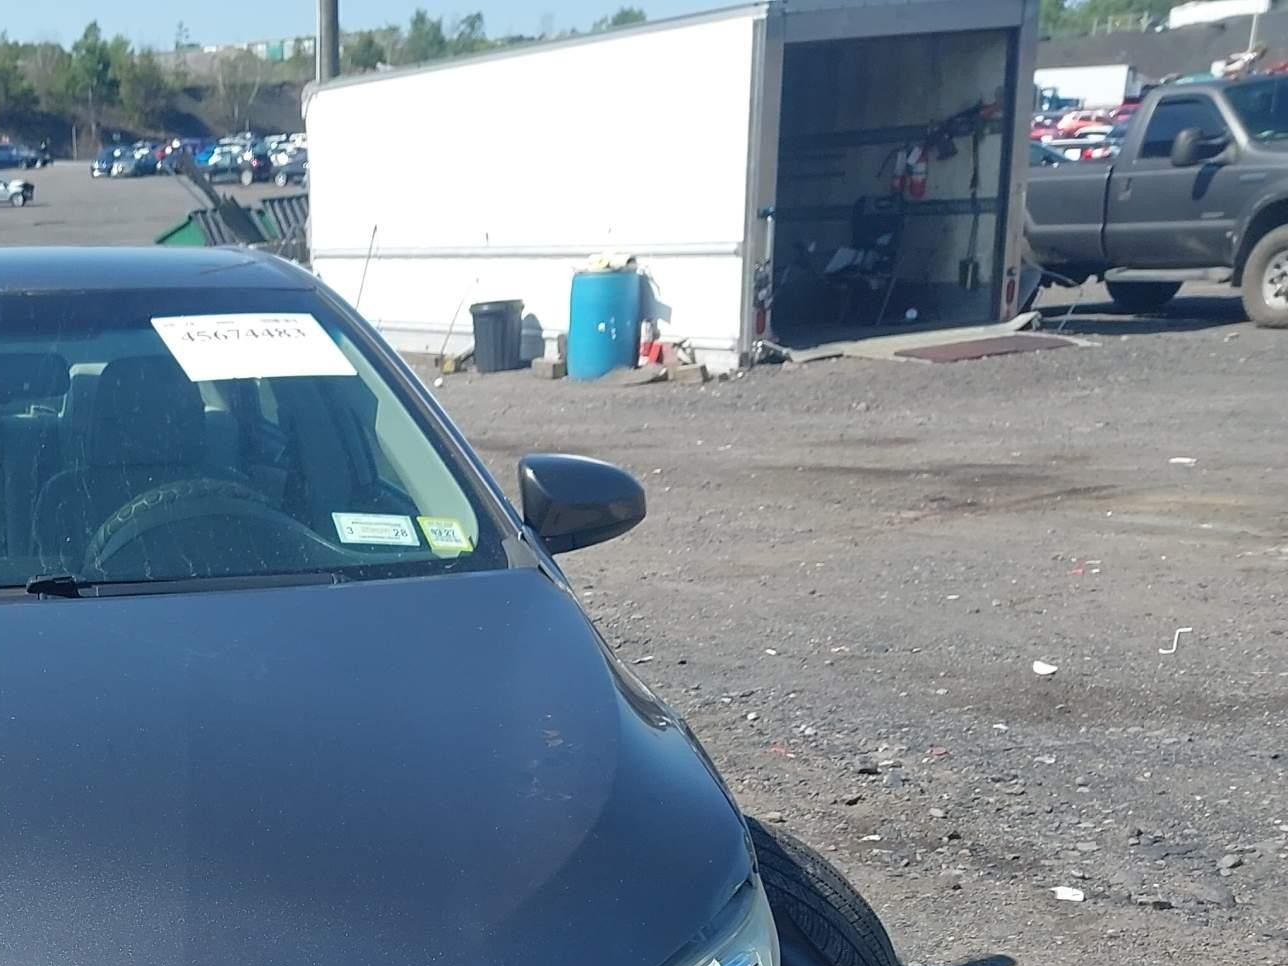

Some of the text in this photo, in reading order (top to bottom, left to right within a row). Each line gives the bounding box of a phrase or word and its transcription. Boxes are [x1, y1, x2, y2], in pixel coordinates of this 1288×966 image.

[182, 327, 306, 343] 45674483
[346, 526, 354, 535] 3
[392, 527, 408, 537] 28
